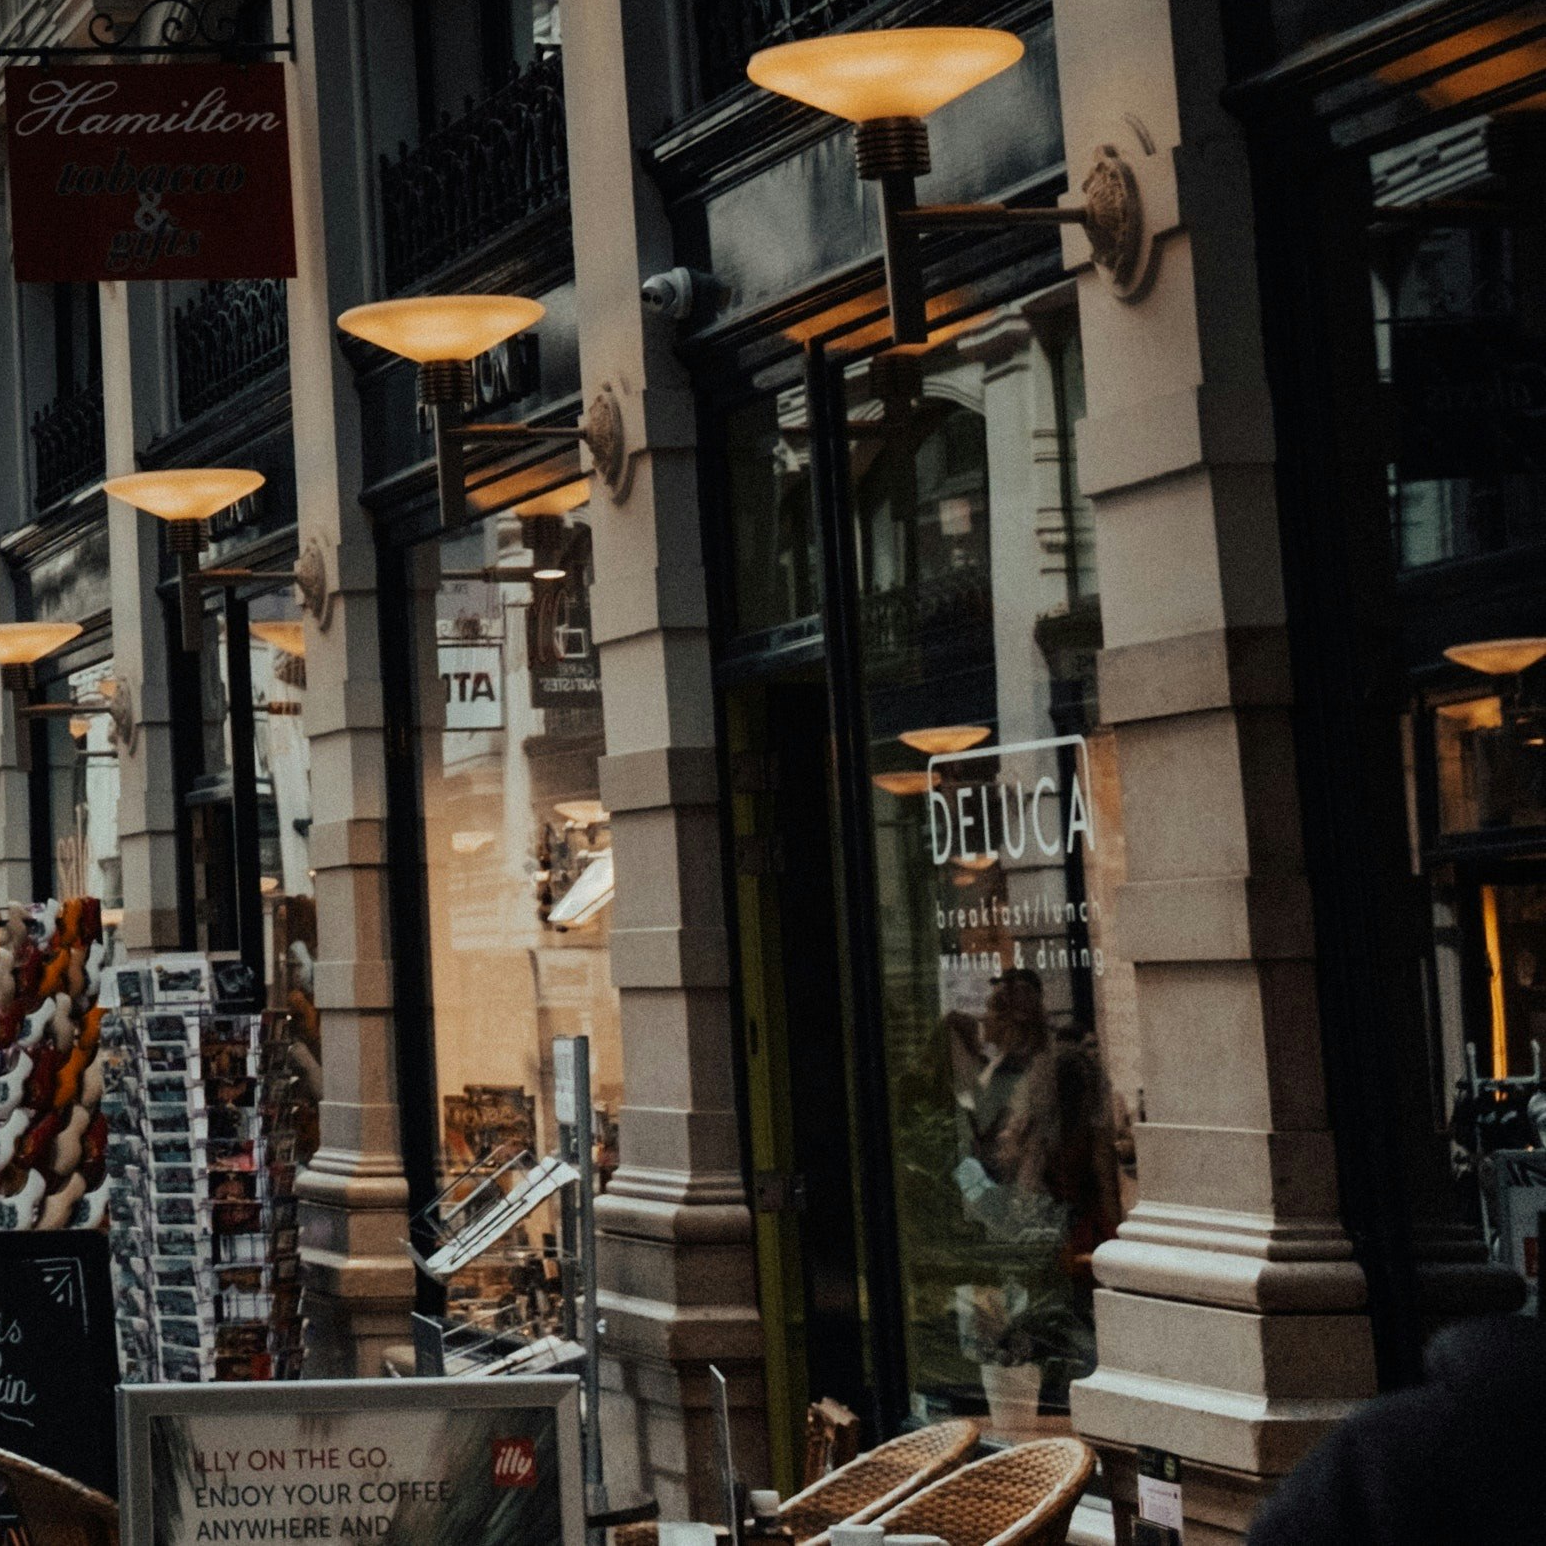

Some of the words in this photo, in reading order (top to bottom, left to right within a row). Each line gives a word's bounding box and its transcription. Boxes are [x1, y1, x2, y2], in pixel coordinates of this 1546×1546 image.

[15, 79, 282, 137] Hamilton
[57, 146, 246, 196] tobacco
[133, 185, 181, 231] &
[106, 215, 202, 272] gifts
[930, 773, 1096, 865] DELUCA
[939, 943, 1002, 978] wining
[1013, 941, 1026, 970] &
[1036, 939, 1105, 977] dining
[247, 1450, 287, 1472] ON
[293, 1448, 340, 1470] THE
[348, 1446, 394, 1469] GO.
[494, 1447, 534, 1481] illy
[195, 1484, 276, 1508] ENJOY
[283, 1482, 351, 1506] YOUR
[359, 1480, 453, 1504] COFFEE
[196, 1517, 332, 1541] ANYWHERE
[340, 1515, 393, 1538] AND
